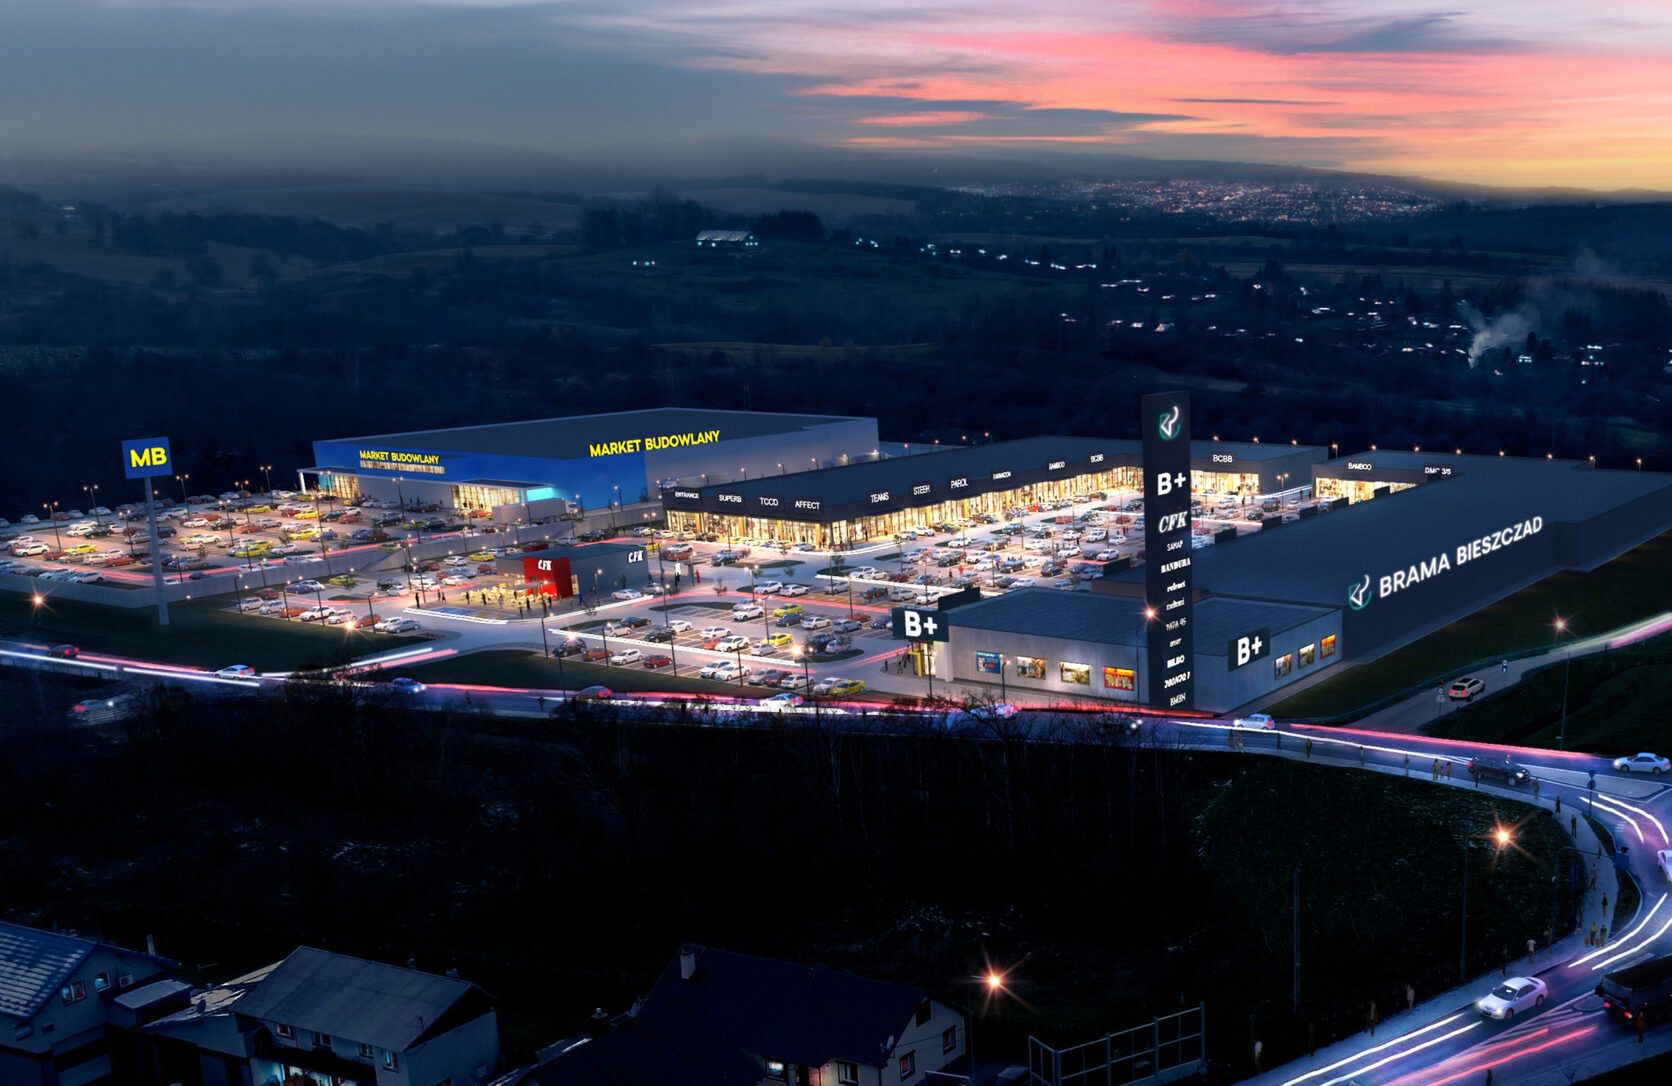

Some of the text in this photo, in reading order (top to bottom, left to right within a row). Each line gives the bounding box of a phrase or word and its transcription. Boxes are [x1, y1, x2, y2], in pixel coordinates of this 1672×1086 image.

[589, 430, 720, 457] MARKET BUDOWLANY
[130, 447, 167, 468] MB
[359, 450, 439, 464] MARKET BUDOWLANY
[1213, 454, 1233, 463] BCBB
[1348, 462, 1372, 471] BAMBOO
[1157, 472, 1186, 496] B+
[674, 491, 700, 499] ENTRANCE
[718, 494, 743, 503] SUPERB
[794, 500, 821, 510] AFFECT
[1159, 511, 1188, 533] CFK
[628, 550, 644, 564] CFK
[1379, 516, 1543, 599] BRAMA BIESZCZAD
[538, 559, 552, 571] CFK
[904, 610, 938, 638] B+
[1237, 635, 1263, 667] B+
